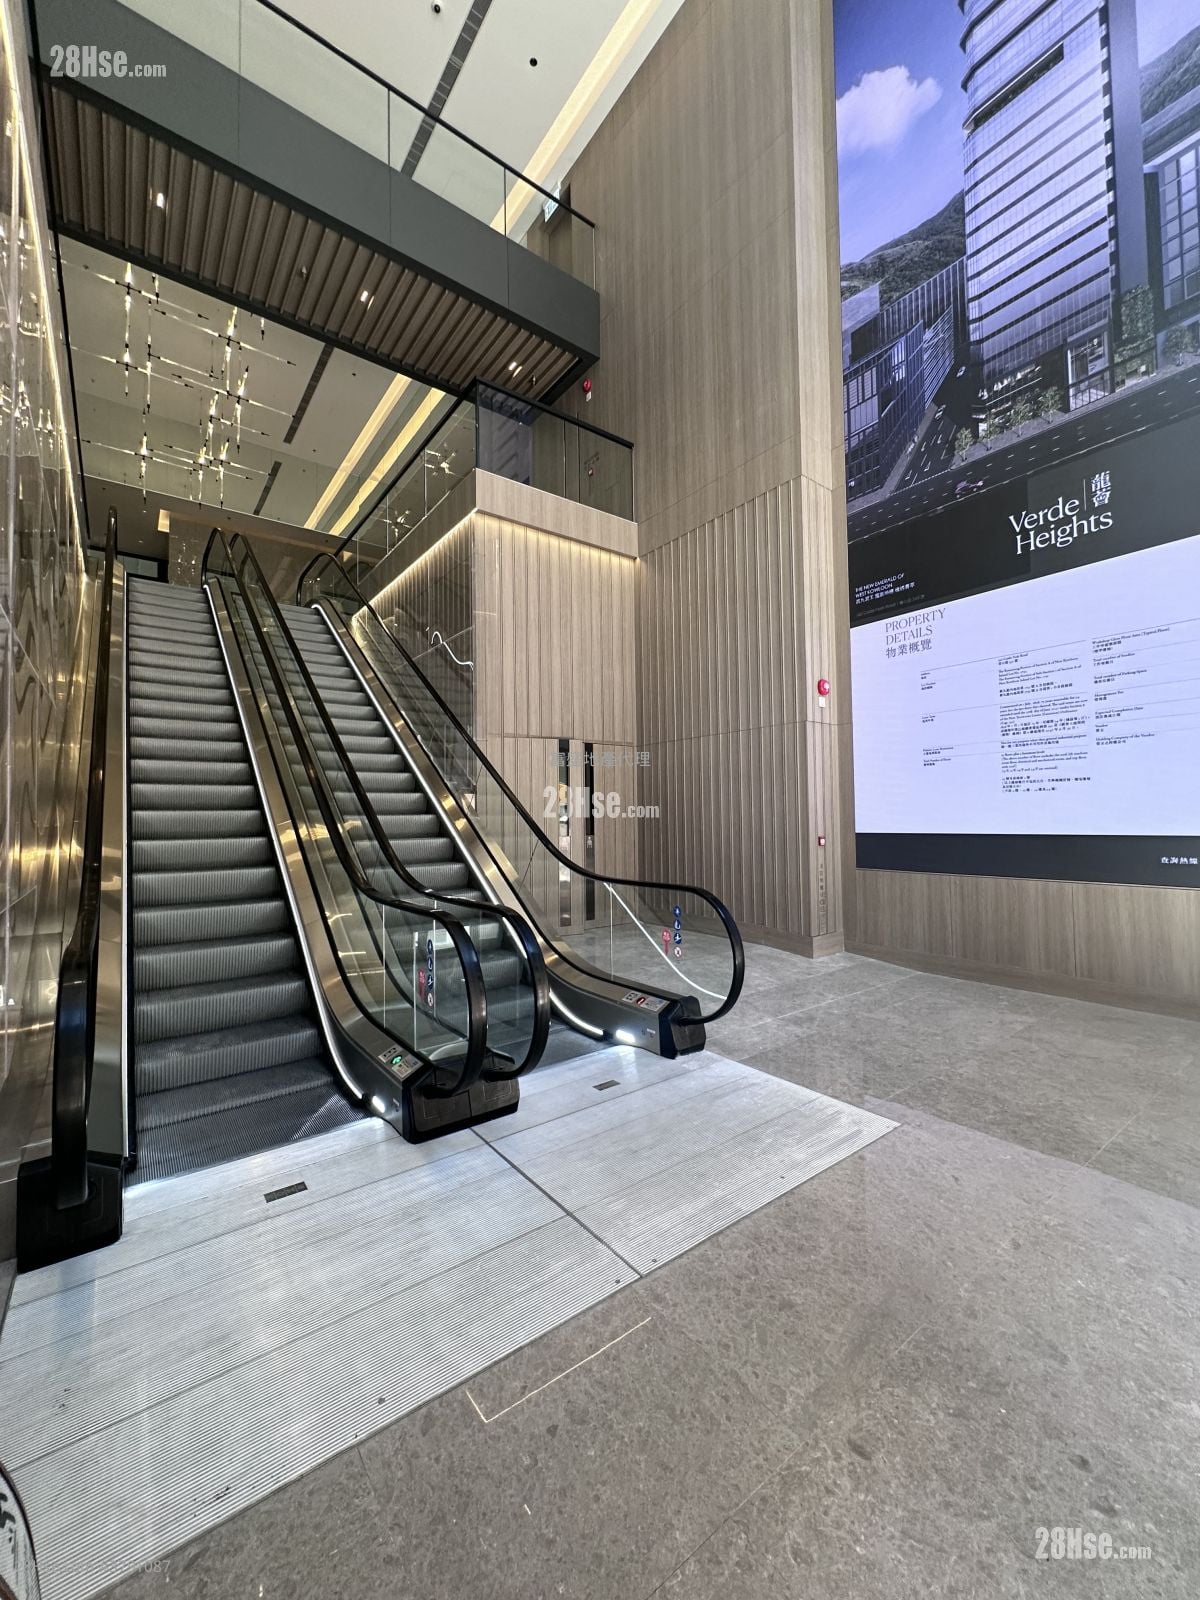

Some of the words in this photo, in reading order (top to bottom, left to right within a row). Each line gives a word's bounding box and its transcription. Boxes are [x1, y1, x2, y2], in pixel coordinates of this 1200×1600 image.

[1008, 496, 1080, 533] Verde
[1016, 512, 1113, 555] Heights
[885, 608, 946, 633] PROPERTY
[886, 625, 933, 645] DETAILS
[886, 638, 932, 659] 物業概覽
